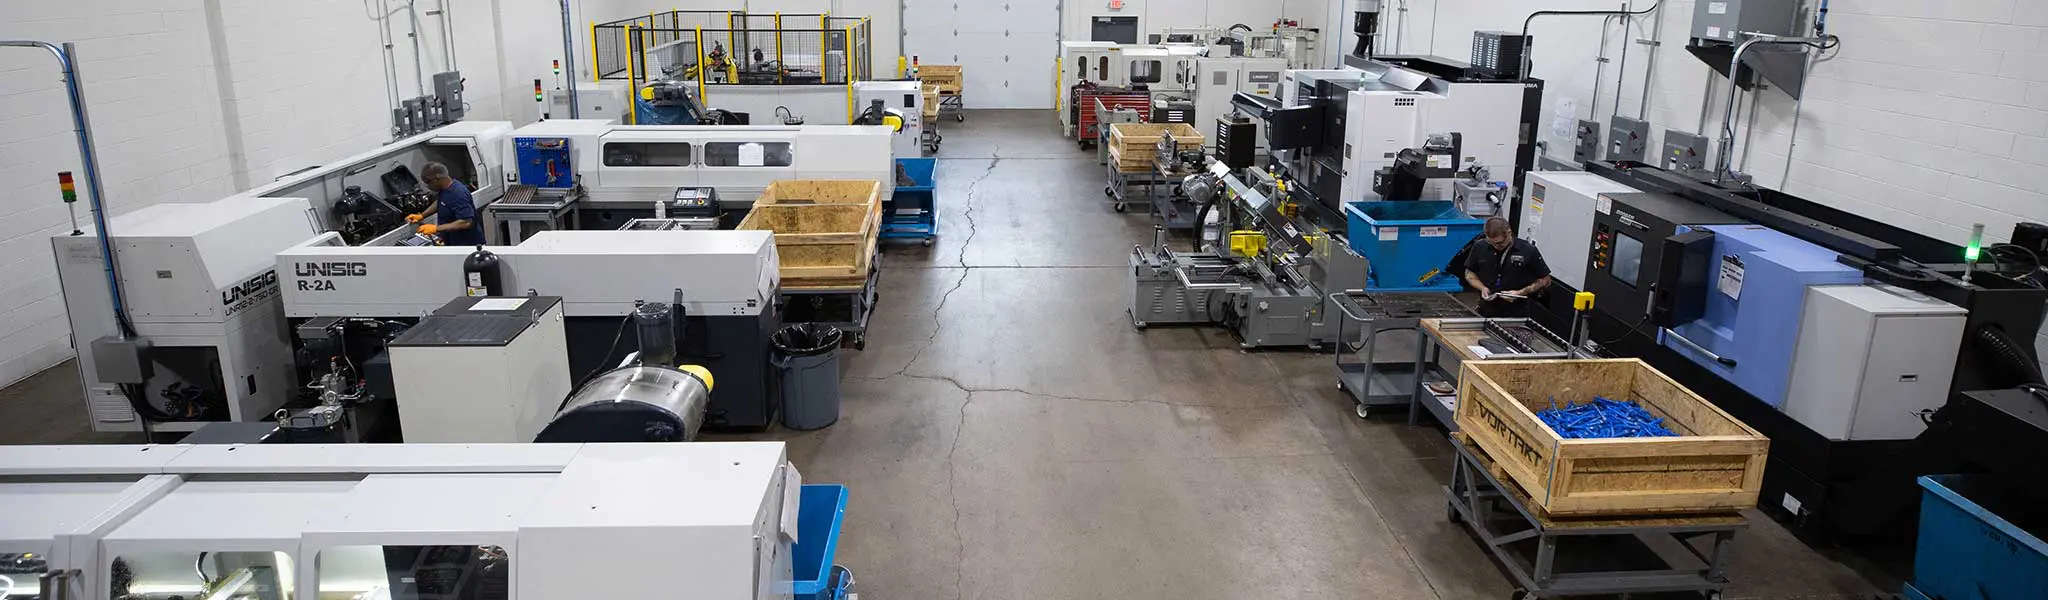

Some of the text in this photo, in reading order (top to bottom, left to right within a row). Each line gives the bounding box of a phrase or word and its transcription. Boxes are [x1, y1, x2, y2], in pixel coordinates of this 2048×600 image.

[295, 262, 367, 277] UNISIG
[222, 269, 276, 306] UNISIG
[297, 280, 336, 291] R-2A
